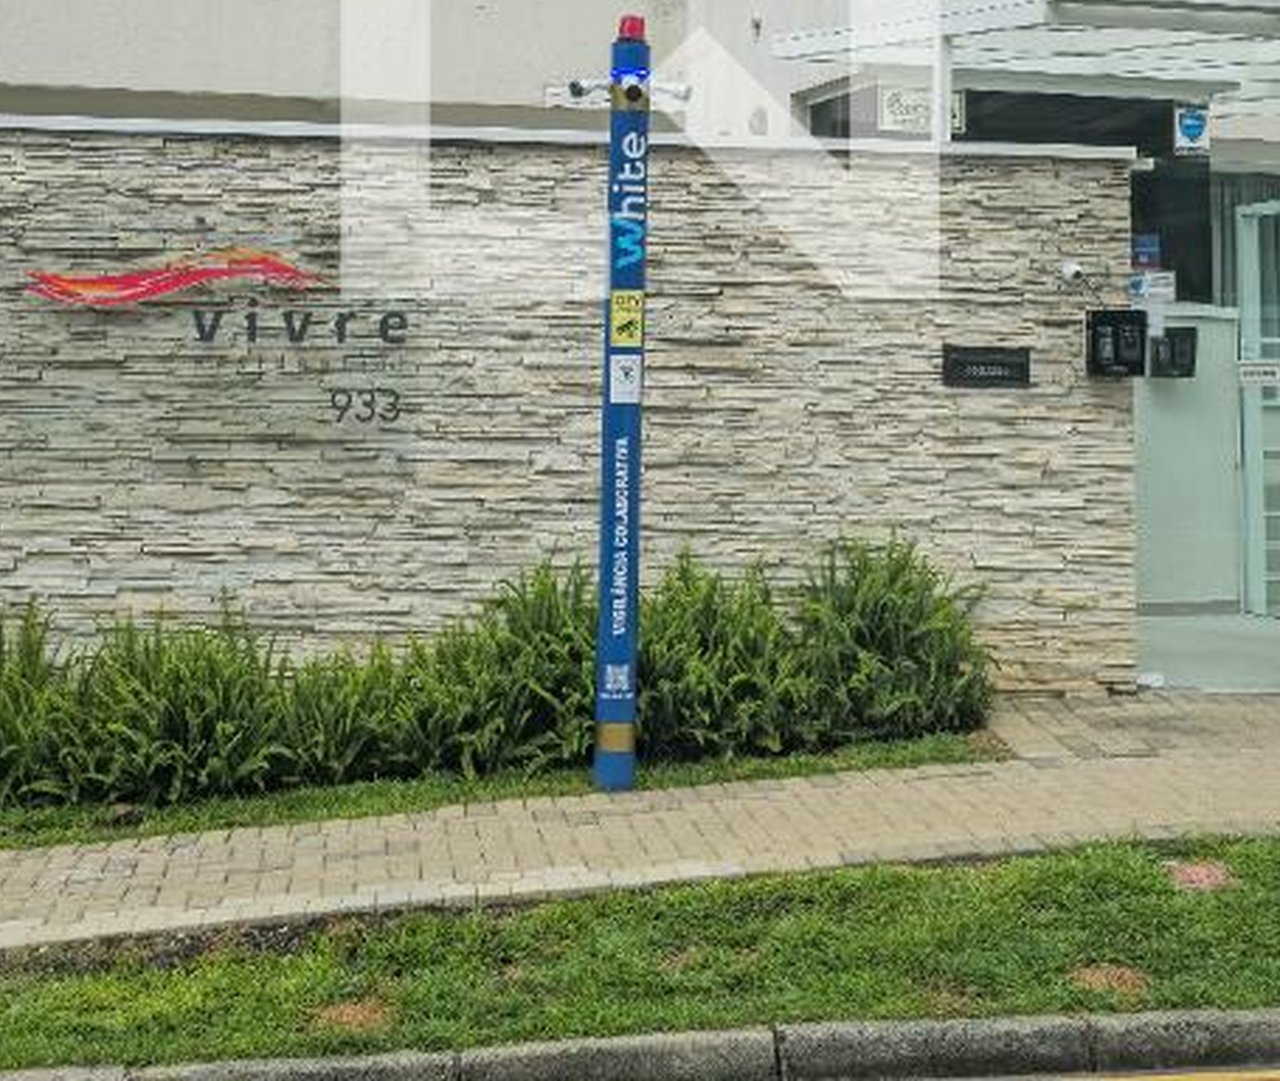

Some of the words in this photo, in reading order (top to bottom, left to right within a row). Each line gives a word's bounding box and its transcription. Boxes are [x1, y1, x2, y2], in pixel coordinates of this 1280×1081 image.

[610, 132, 646, 269] White
[192, 297, 410, 344] vivre
[331, 386, 402, 424] 933
[613, 437, 629, 548] COLABORATIVA
